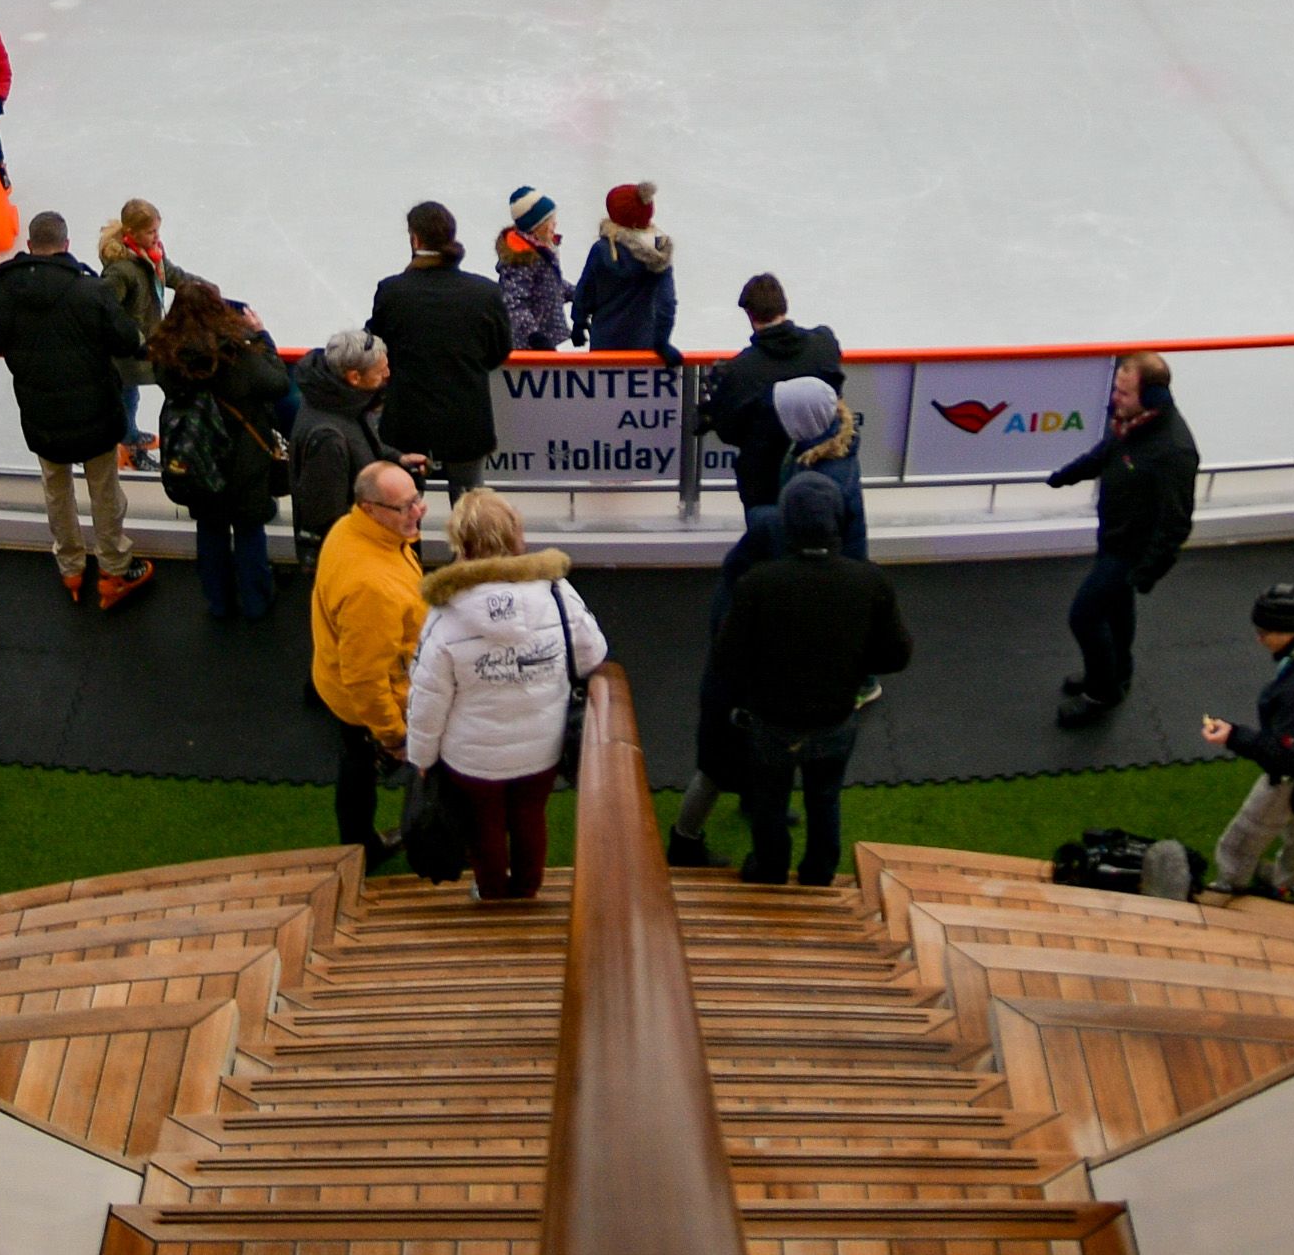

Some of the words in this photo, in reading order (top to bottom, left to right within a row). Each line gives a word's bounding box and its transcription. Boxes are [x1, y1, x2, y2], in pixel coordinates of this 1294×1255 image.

[502, 369, 678, 399] WINTER
[617, 409, 677, 429] AUF
[1004, 409, 1085, 434] AIDA
[485, 452, 535, 471] MIT
[547, 440, 675, 474] Holiday
[705, 450, 736, 469] on
